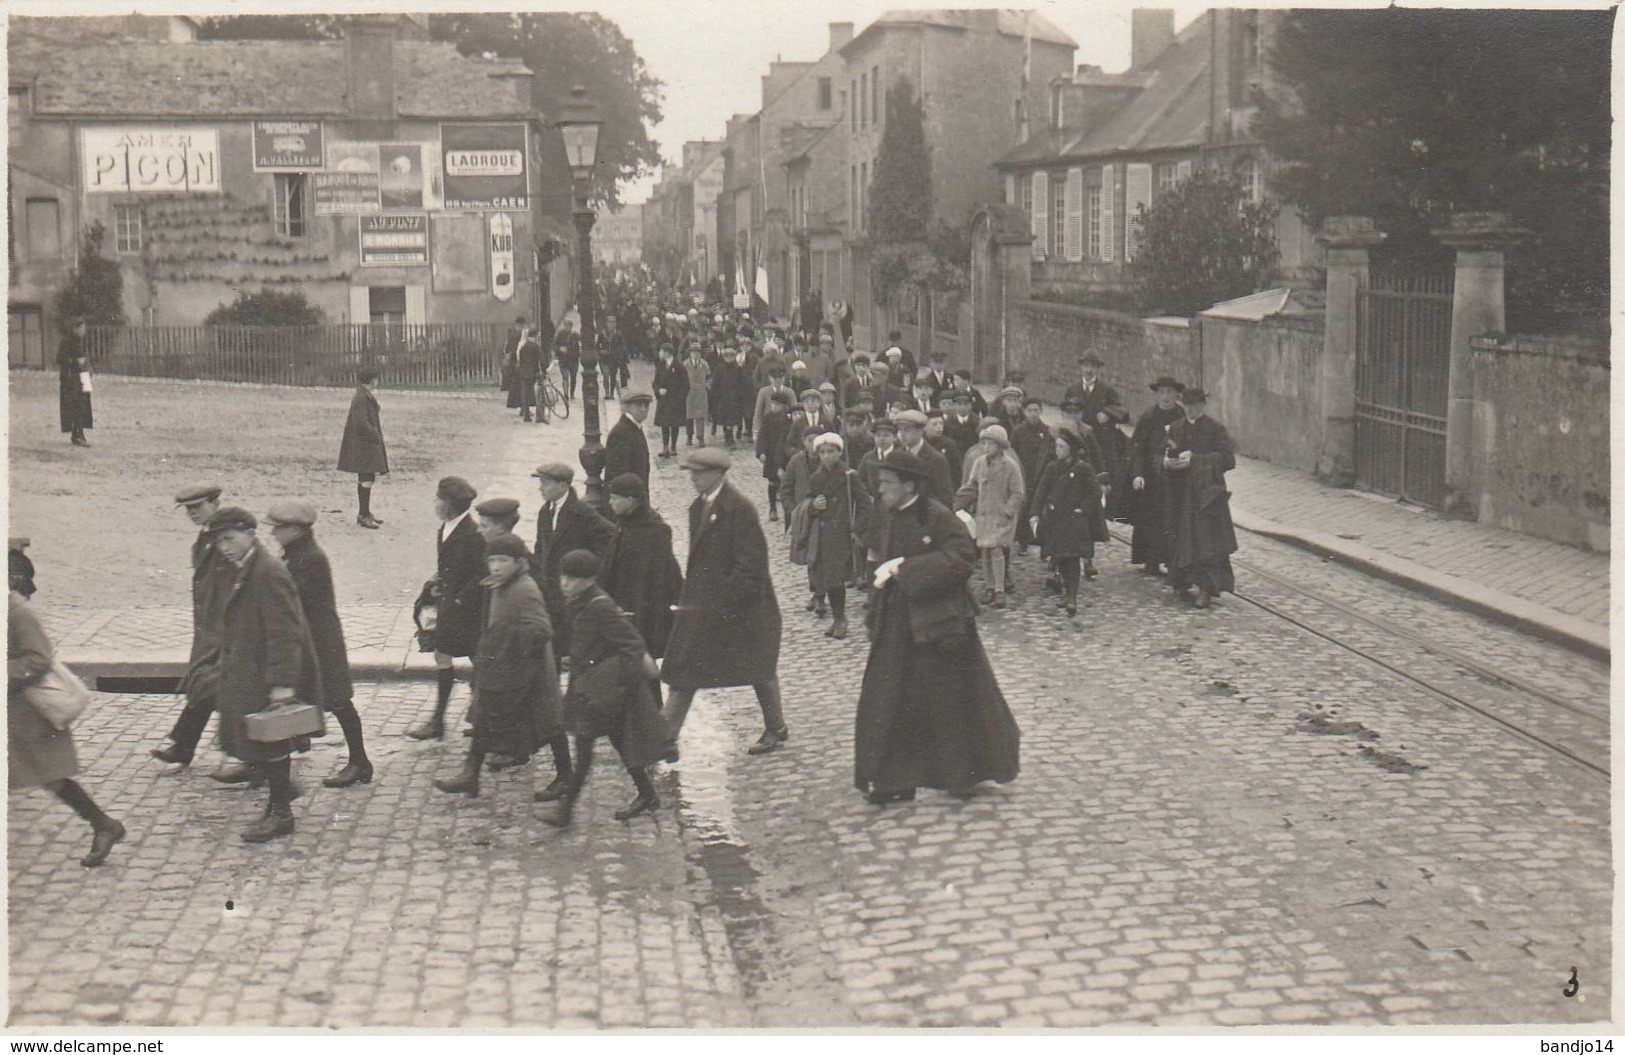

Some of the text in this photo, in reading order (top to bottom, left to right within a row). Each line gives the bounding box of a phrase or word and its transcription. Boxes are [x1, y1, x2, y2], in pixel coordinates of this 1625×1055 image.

[93, 150, 214, 185] PICON
[493, 196, 525, 208] CAEN
[491, 234, 512, 252] KUB
[1563, 966, 1579, 998] 3
